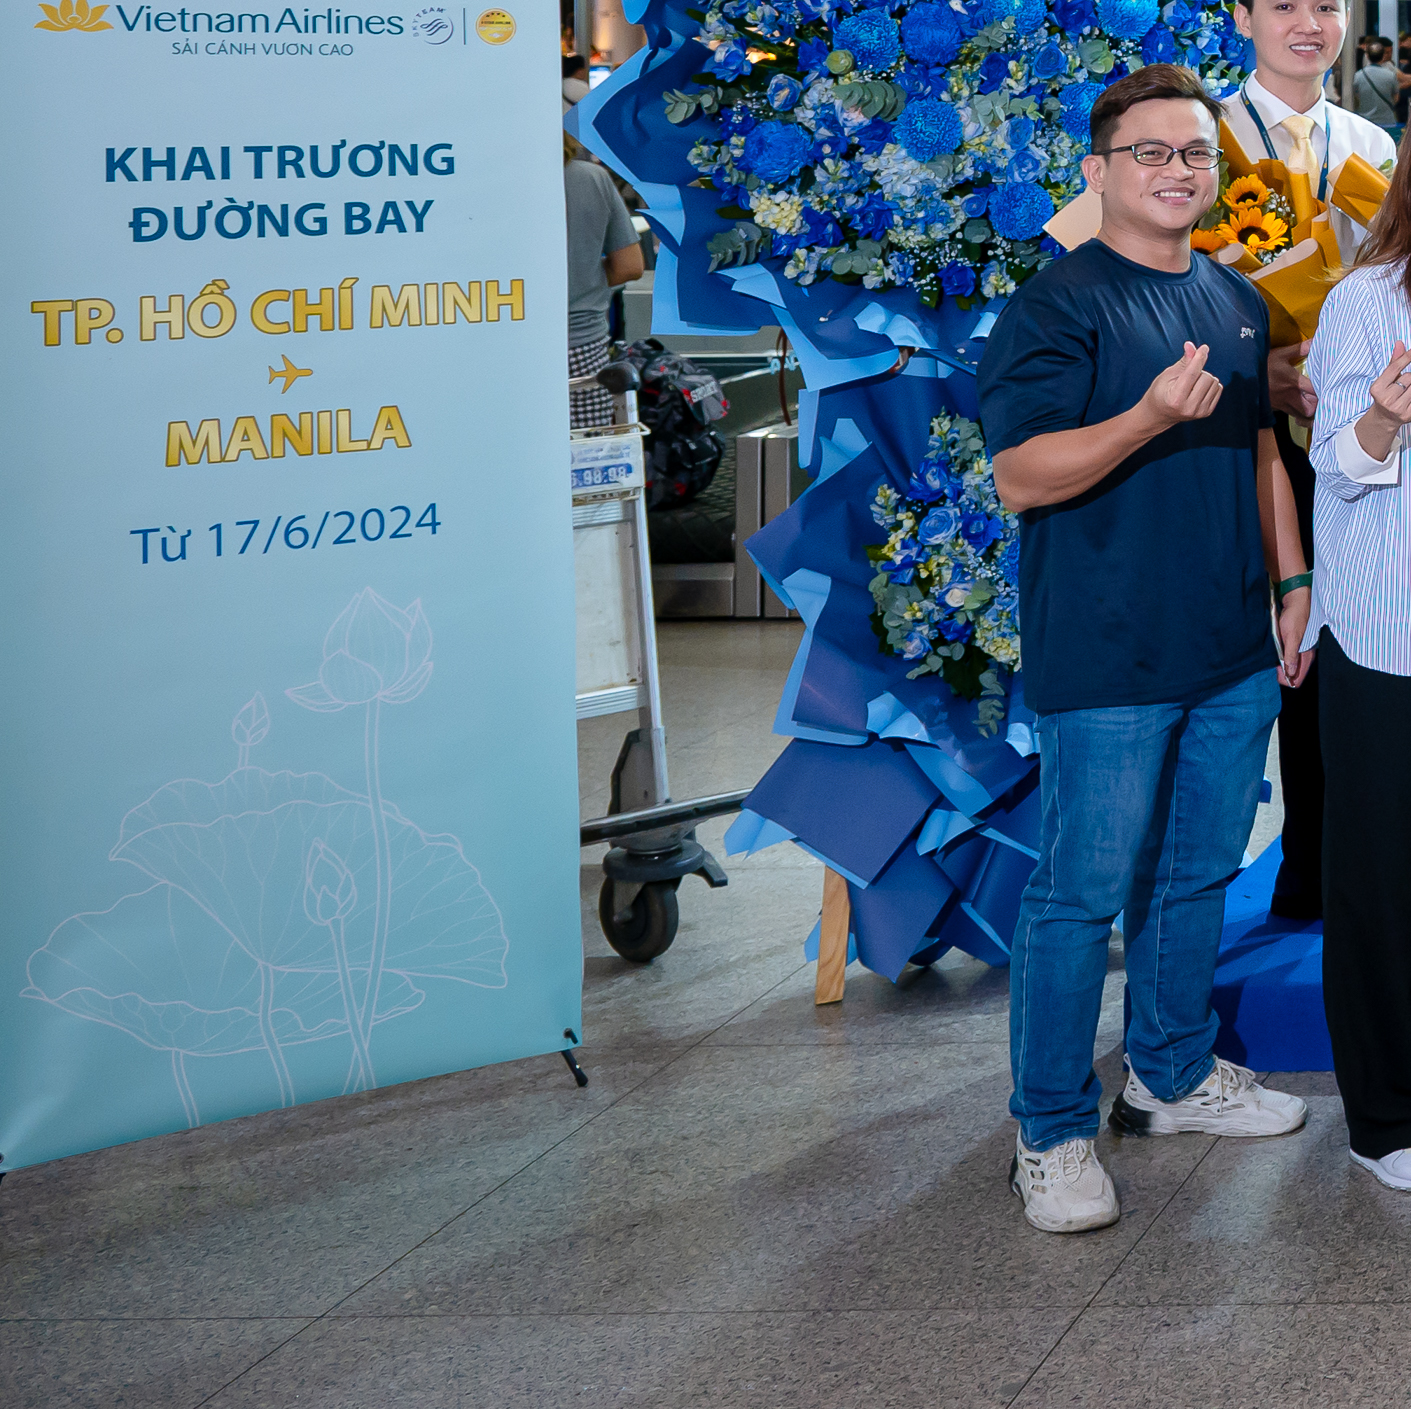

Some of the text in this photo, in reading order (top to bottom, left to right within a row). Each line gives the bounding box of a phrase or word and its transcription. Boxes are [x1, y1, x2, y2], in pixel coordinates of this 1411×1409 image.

[116, 4, 404, 35] Vietnam Airlines
[172, 38, 198, 55] SẢI
[205, 40, 256, 56] CÁNH
[318, 43, 354, 56] CAO
[105, 138, 456, 183] KHAI TRƯƠNG
[128, 199, 435, 244] ĐƯỜNG BAY
[30, 276, 526, 347] TP. HỒ CHÍ MINH
[165, 405, 412, 468] MANILA
[130, 502, 443, 565] Từ 17/6/2024
